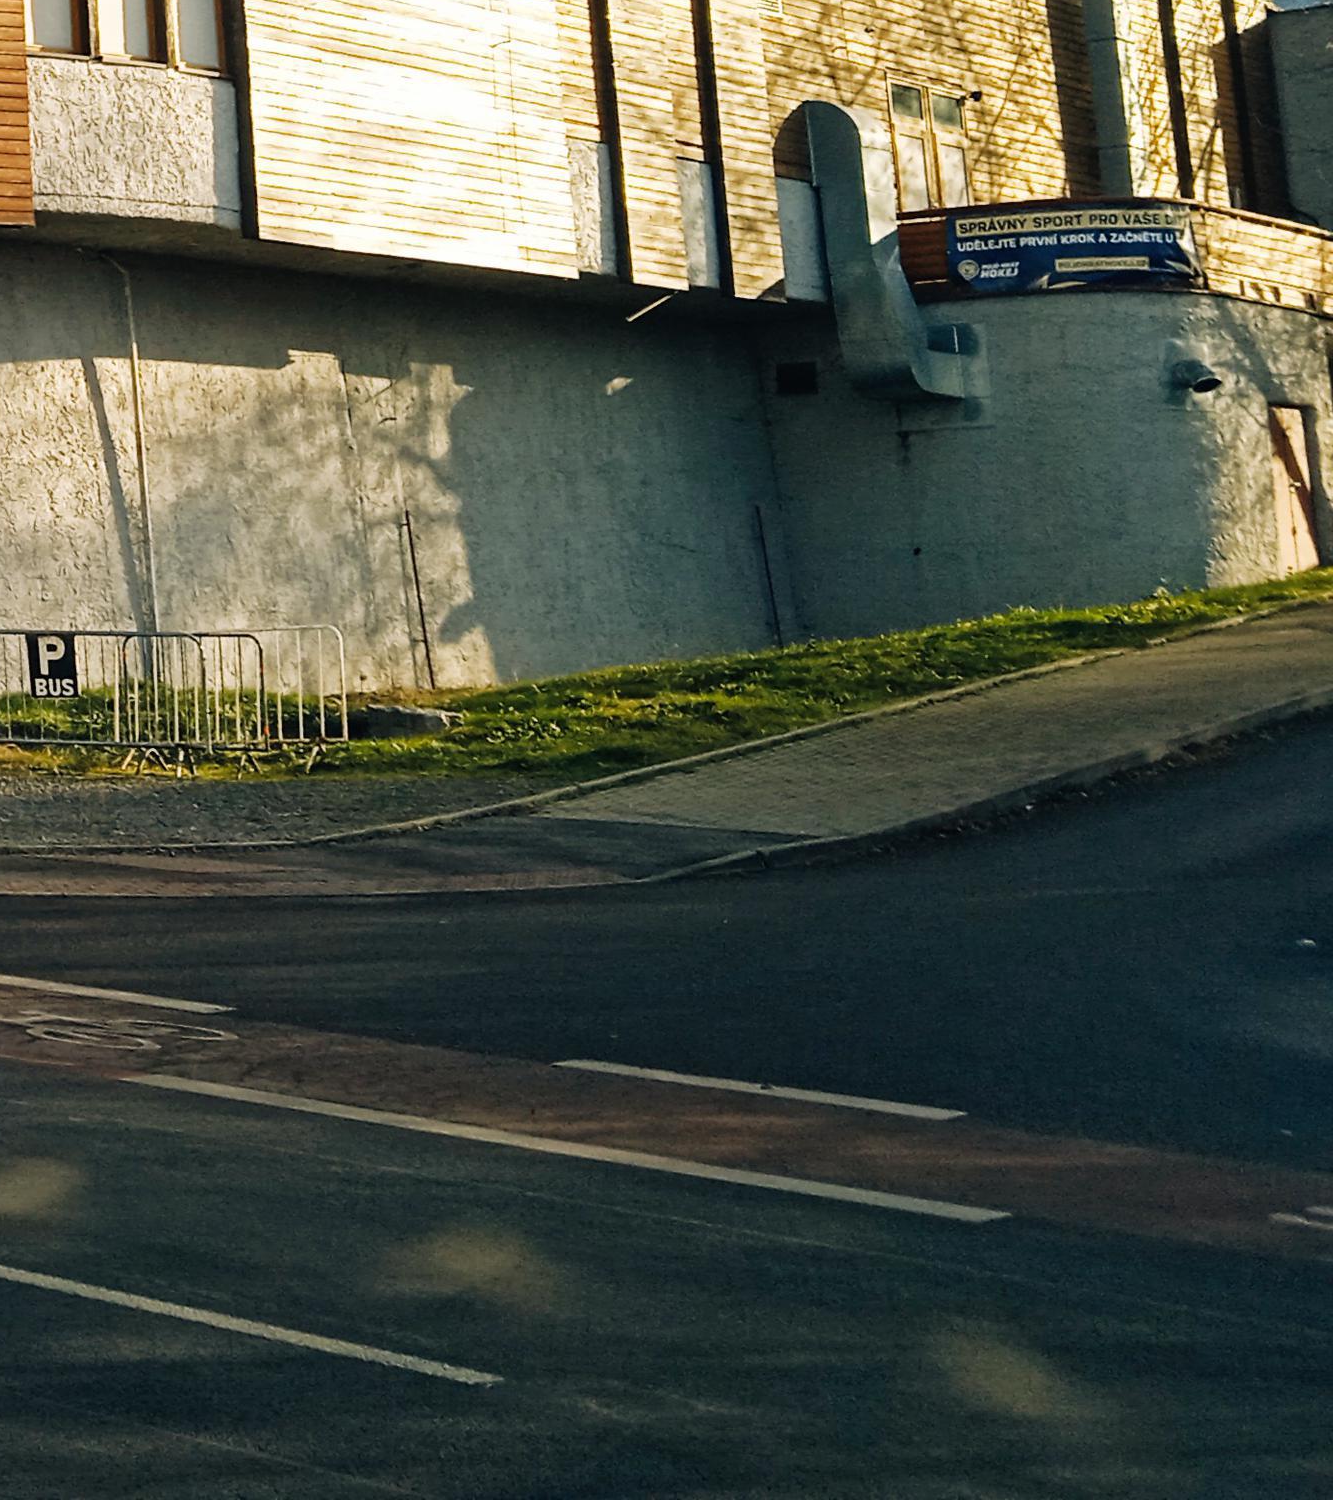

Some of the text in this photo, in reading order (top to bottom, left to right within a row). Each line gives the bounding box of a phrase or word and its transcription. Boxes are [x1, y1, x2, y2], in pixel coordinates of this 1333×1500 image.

[1033, 214, 1083, 229] SPORT
[1089, 213, 1118, 225] PRO
[1122, 211, 1161, 225] VAŠE
[1019, 233, 1058, 247] PRVNÍ
[1060, 232, 1096, 244] KROK
[1098, 233, 1108, 243] A
[38, 636, 66, 676] P
[35, 678, 75, 697] BUS
